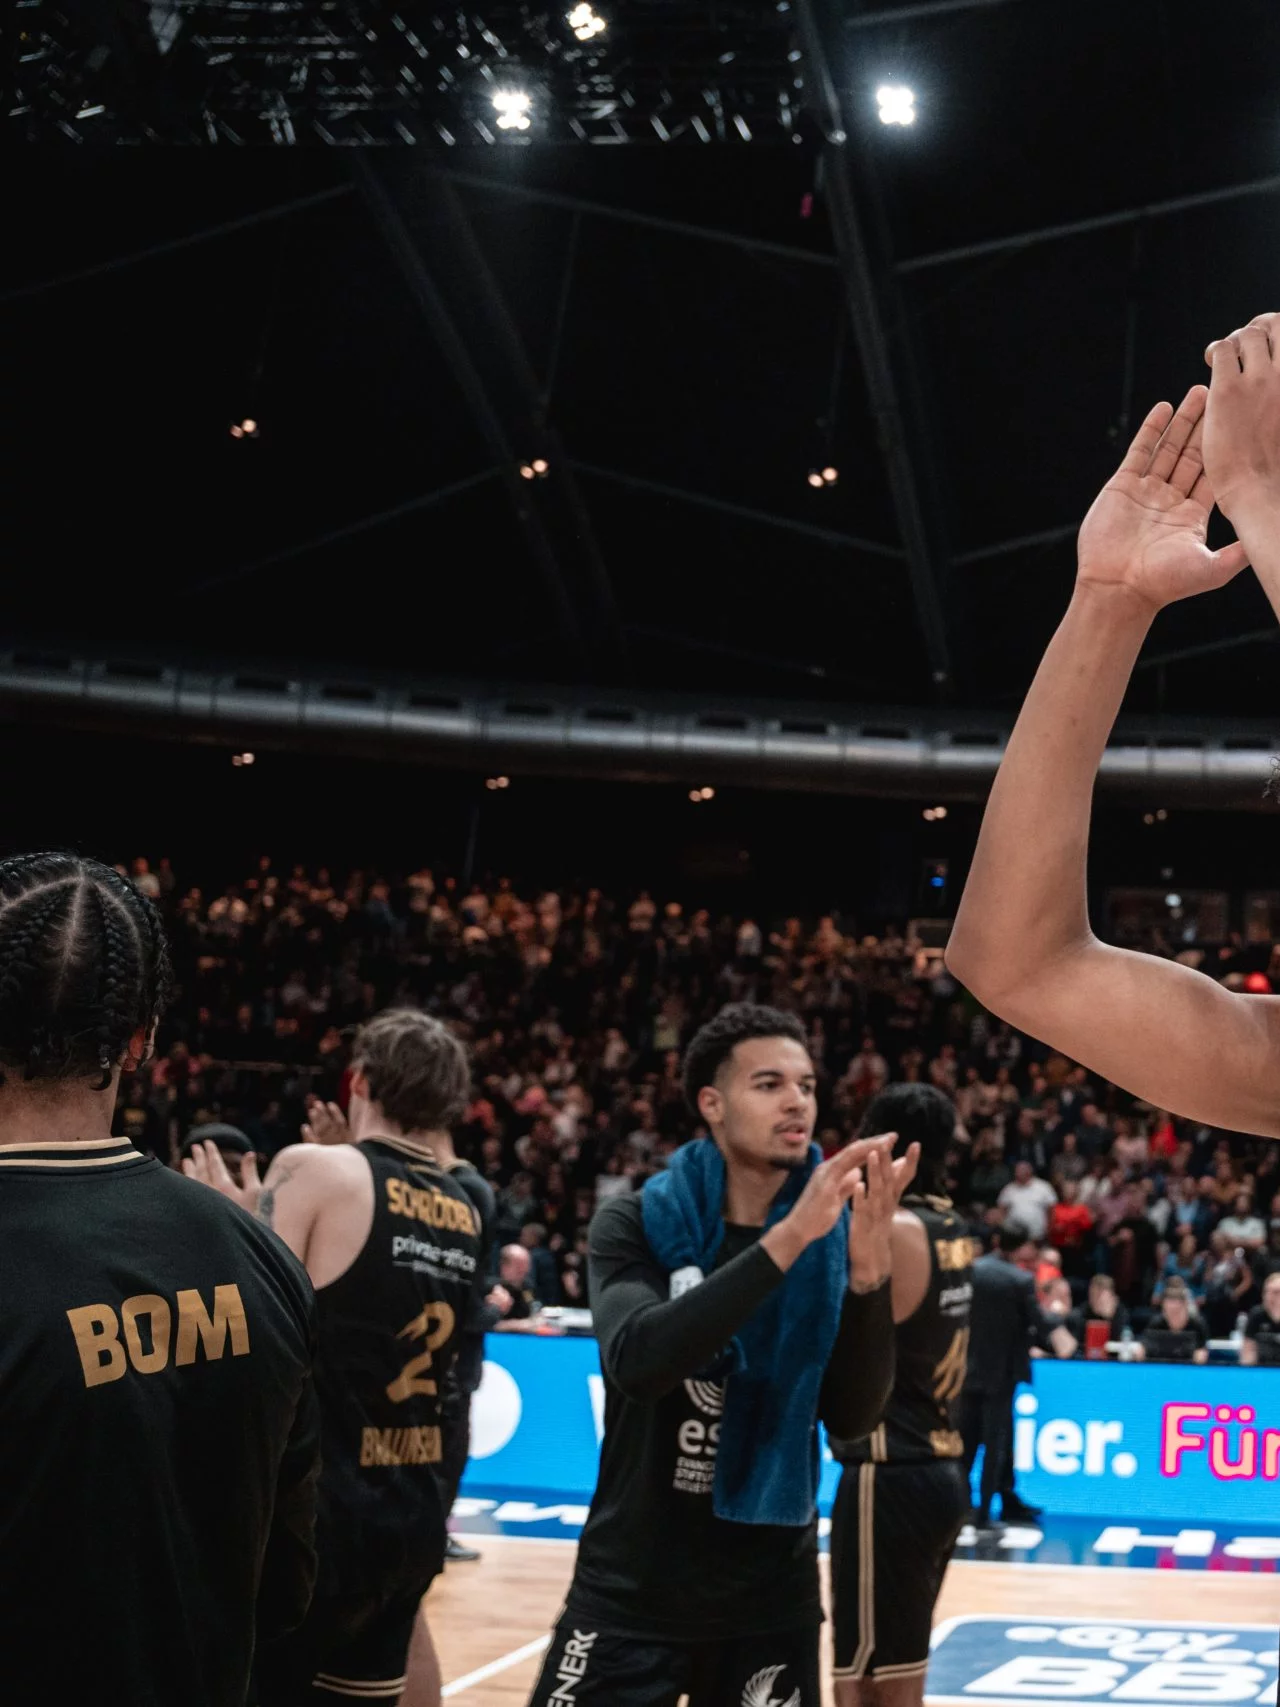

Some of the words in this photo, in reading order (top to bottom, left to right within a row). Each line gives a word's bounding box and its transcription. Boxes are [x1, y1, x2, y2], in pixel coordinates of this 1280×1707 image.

[66, 1283, 250, 1388] BOM
[386, 1301, 456, 1404] 2
[1014, 1393, 1138, 1478] ier.
